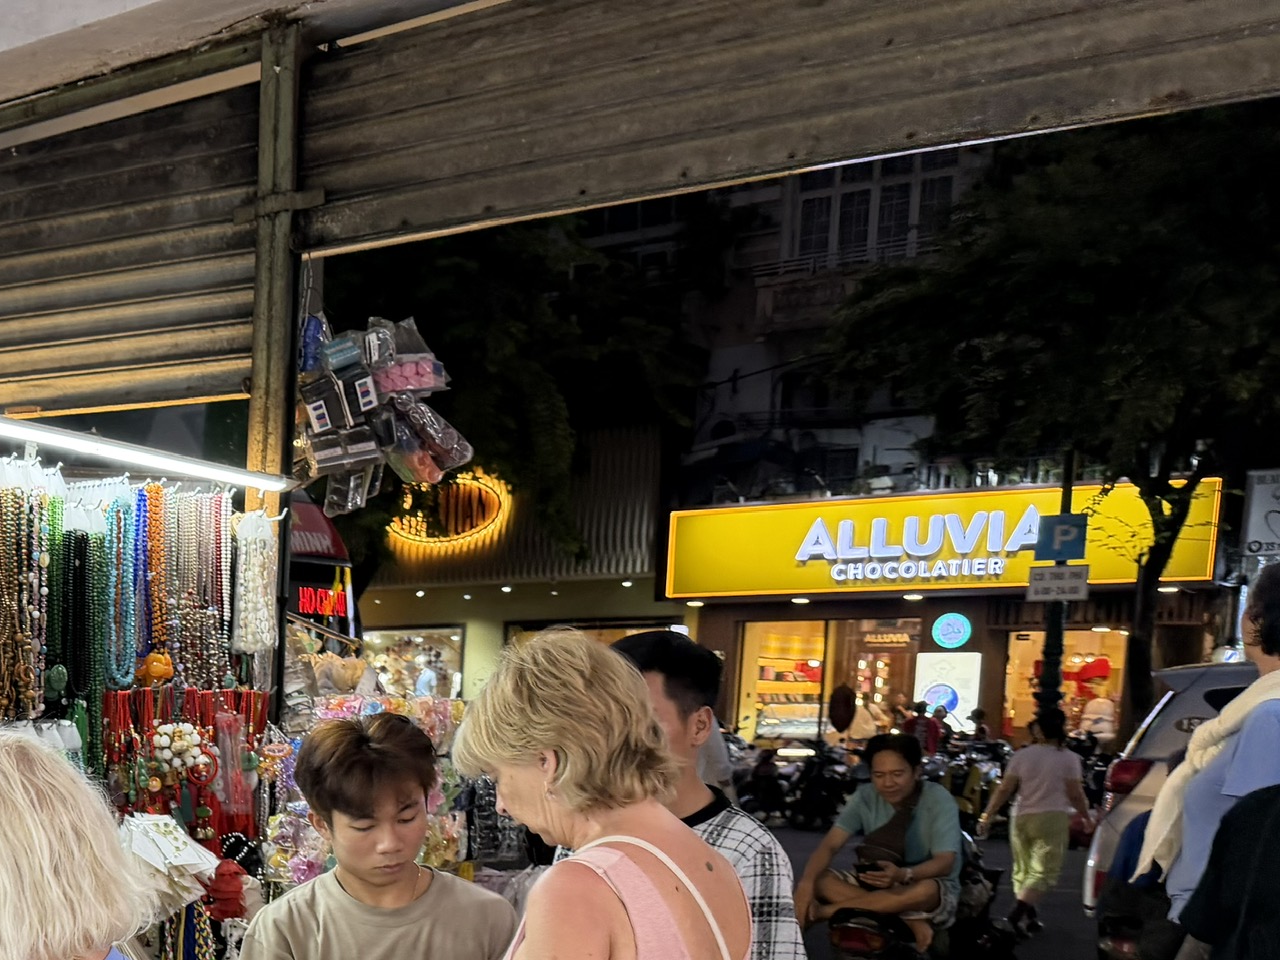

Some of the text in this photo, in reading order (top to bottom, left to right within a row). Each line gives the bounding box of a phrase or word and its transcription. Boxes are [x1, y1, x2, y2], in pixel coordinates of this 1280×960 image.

[795, 504, 1039, 560] ALLUVIA
[1053, 525, 1078, 550] P
[830, 558, 1004, 580] CHOCOLATIER
